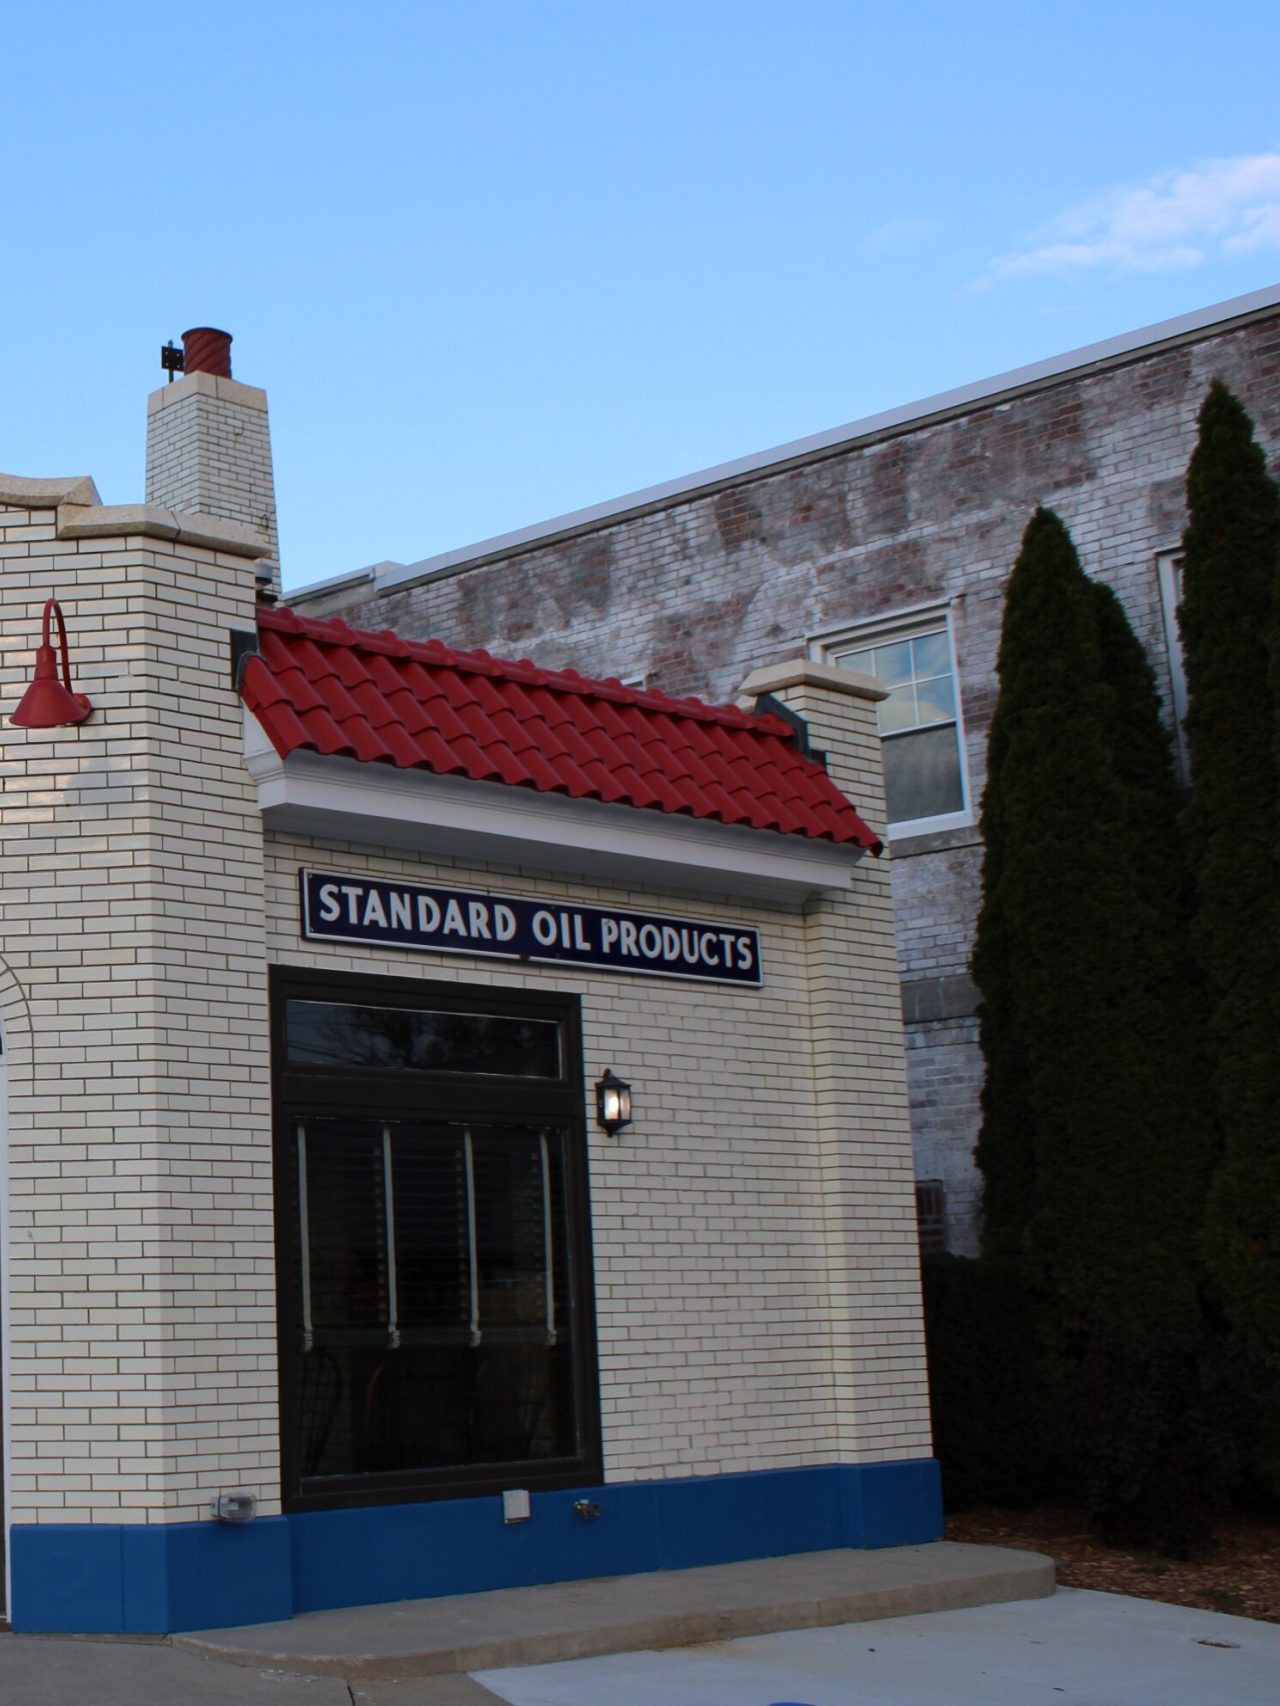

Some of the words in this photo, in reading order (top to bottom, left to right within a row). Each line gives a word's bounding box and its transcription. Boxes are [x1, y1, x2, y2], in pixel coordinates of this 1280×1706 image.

[319, 883, 518, 942] STANDARD
[532, 909, 592, 952] OIL
[601, 917, 753, 971] PRODUCTS
